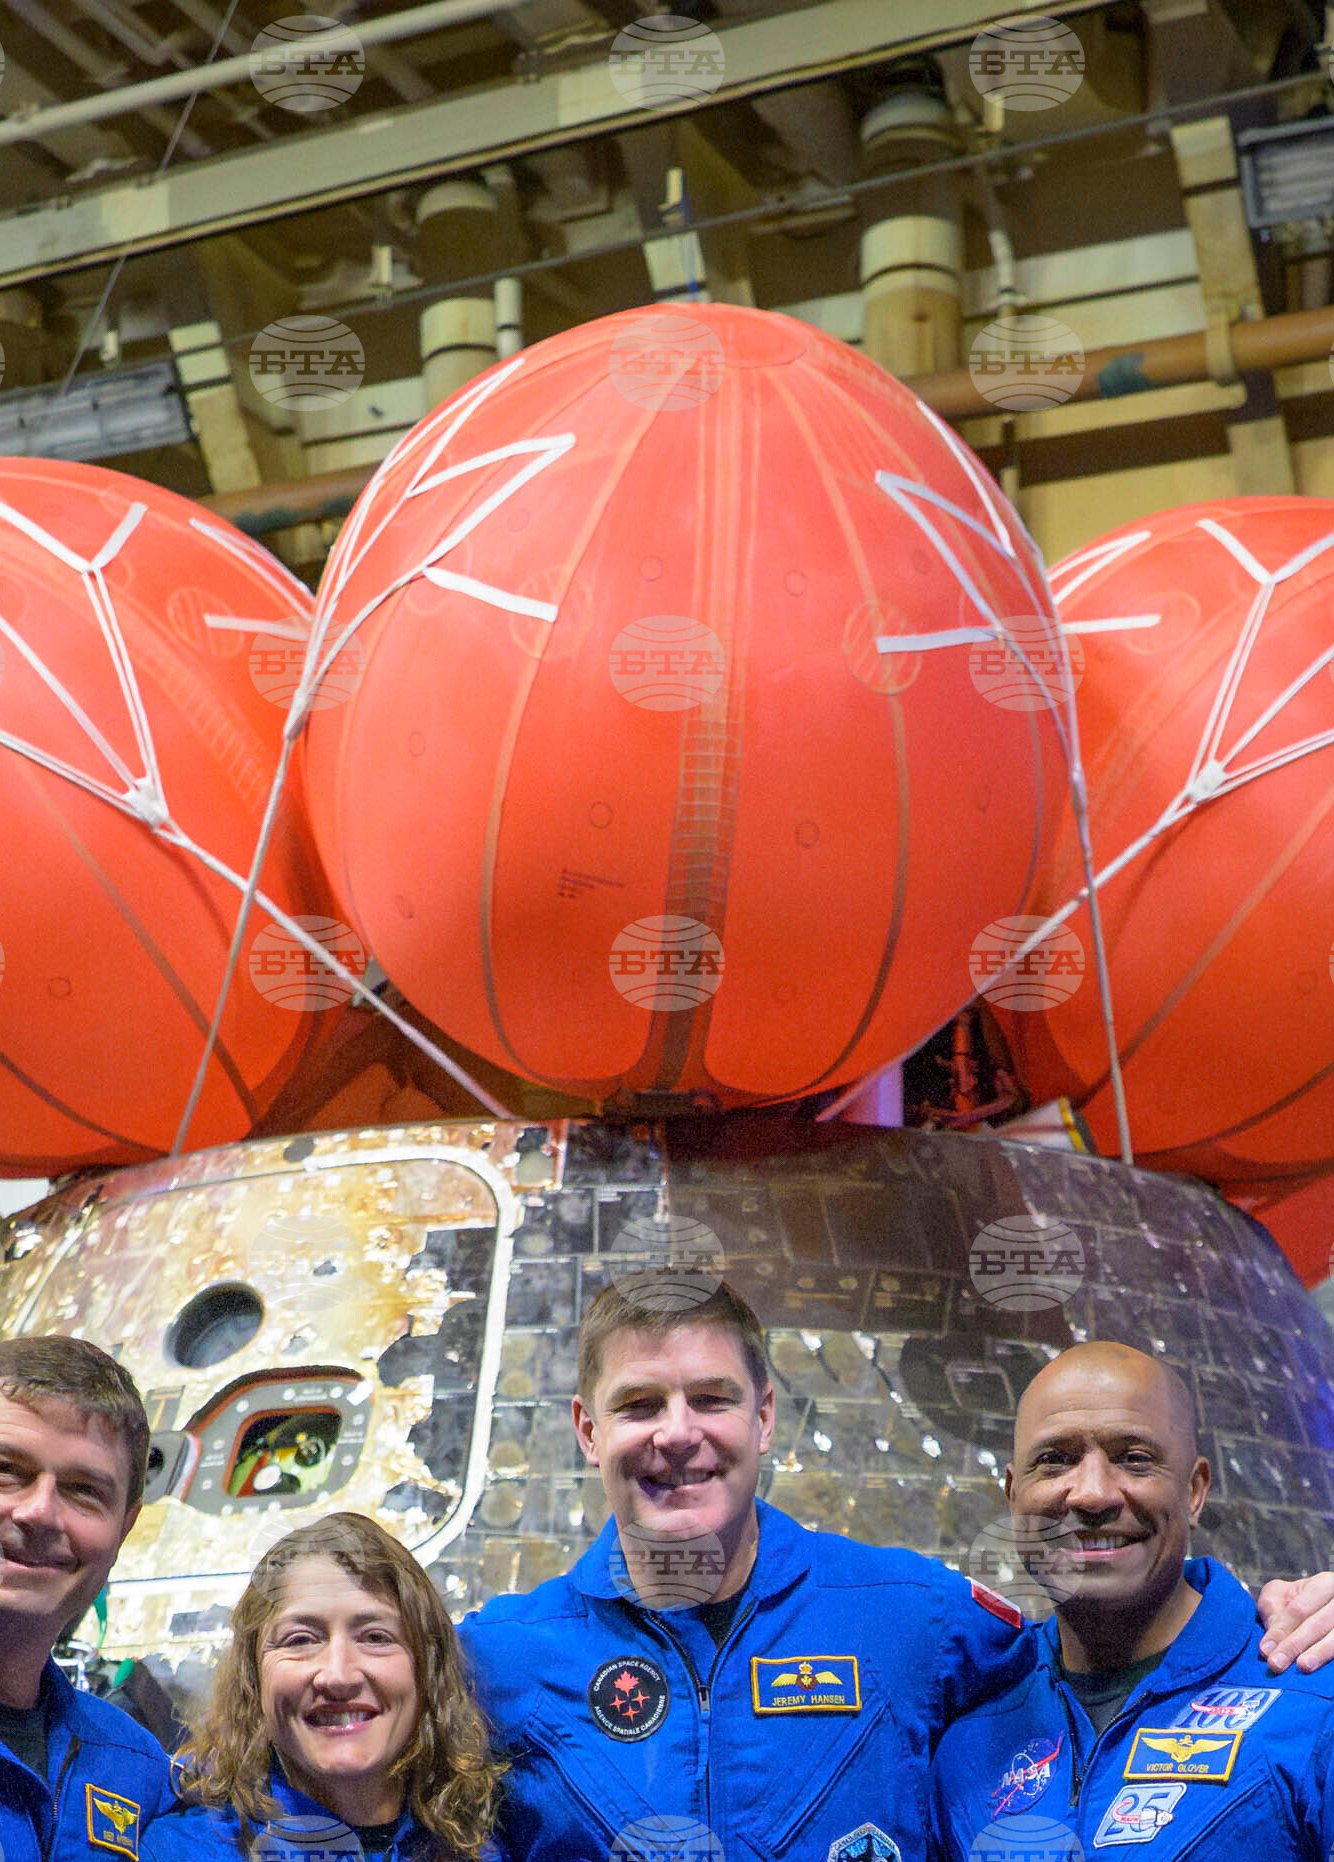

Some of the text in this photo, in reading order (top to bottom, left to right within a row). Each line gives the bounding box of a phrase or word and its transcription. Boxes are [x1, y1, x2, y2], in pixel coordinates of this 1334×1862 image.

[593, 1660, 662, 1692] CANADIAN SPACE AGENCY
[594, 1694, 666, 1736] AGENCE SPATIALE CANADIENNE
[771, 1695, 846, 1707] JEREMY HANSEN
[1176, 1689, 1272, 1730] 100
[1001, 1762, 1052, 1788] NASA
[1146, 1763, 1210, 1773] VICTOR GLOVER
